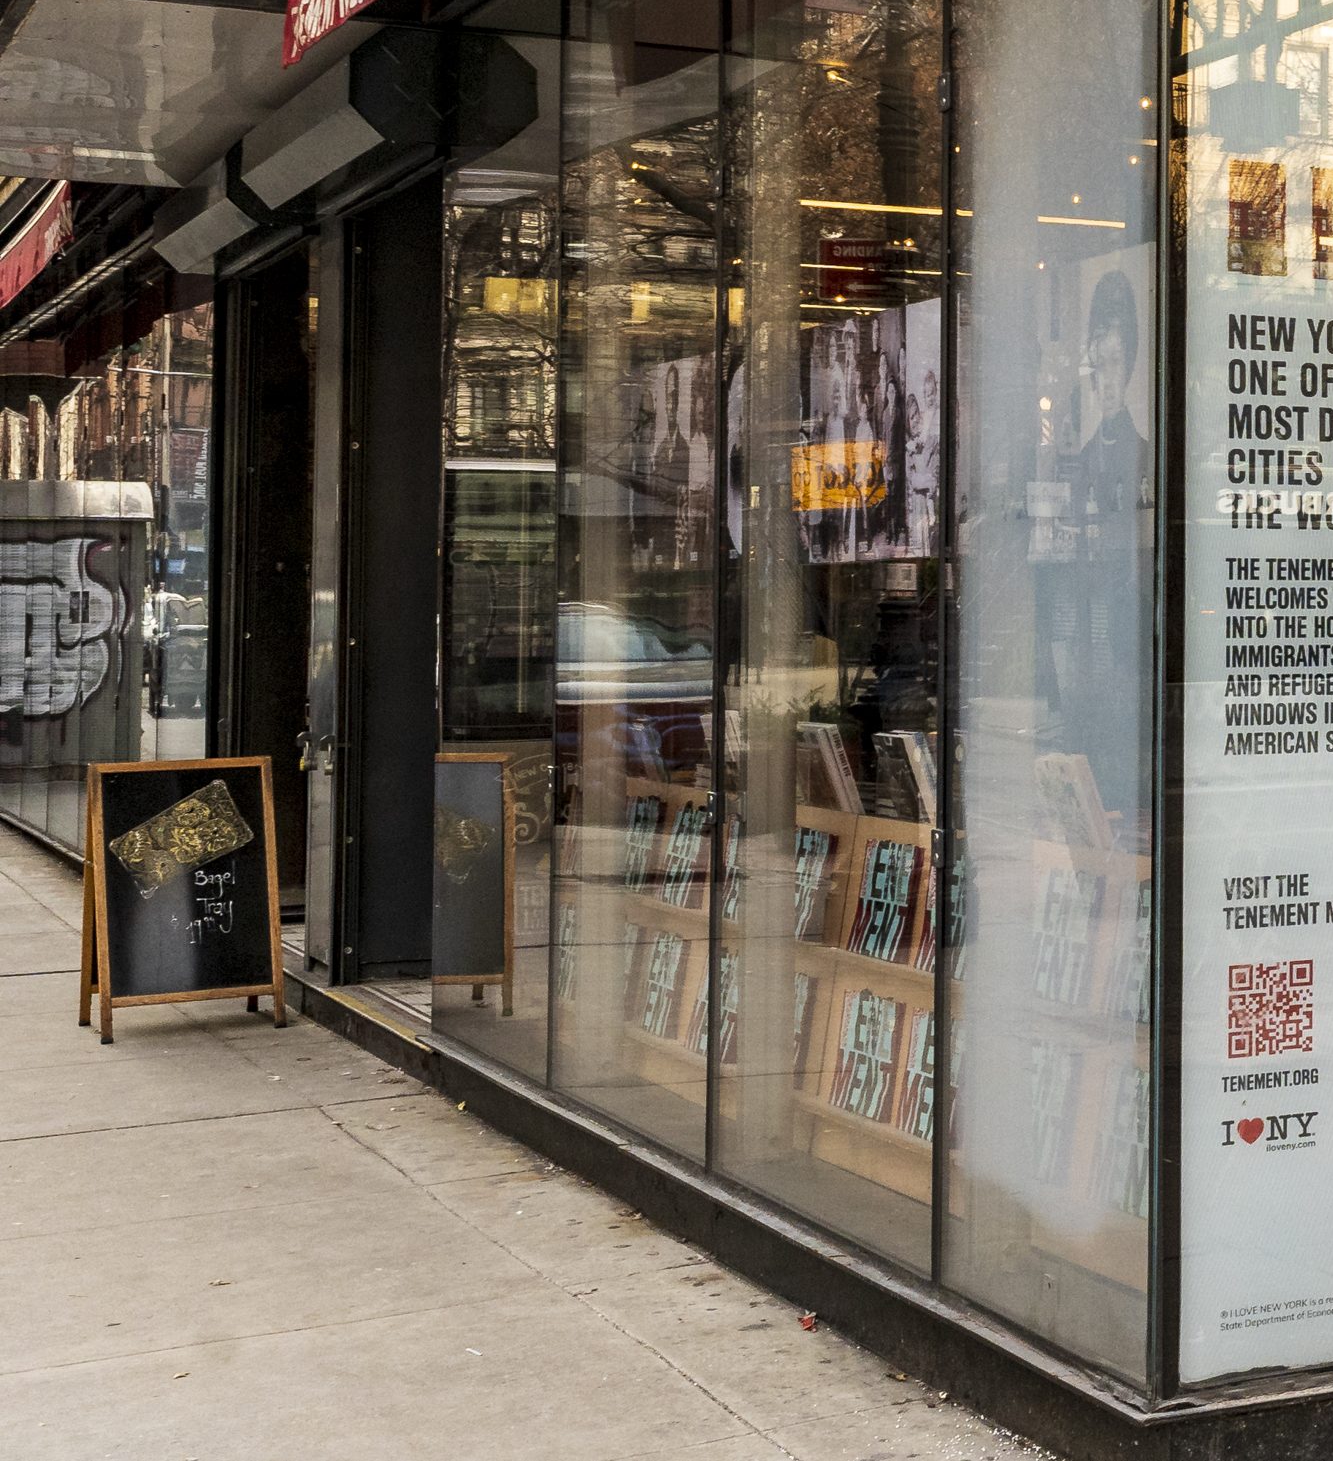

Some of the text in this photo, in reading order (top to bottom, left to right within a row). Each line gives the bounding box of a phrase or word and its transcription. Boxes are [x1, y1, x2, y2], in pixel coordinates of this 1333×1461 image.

[1227, 313, 1296, 352] NEW
[1228, 358, 1287, 396] ONE
[1228, 404, 1308, 442] MOST
[1228, 448, 1323, 487] CITIES
[1231, 493, 1282, 529] THE
[1226, 558, 1260, 580] THE
[1226, 587, 1328, 609] WELCOMES
[1226, 617, 1267, 638] INTO
[1273, 616, 1307, 638] THE
[1225, 674, 1262, 696] AND
[1225, 702, 1317, 726] WINDOWS
[1225, 731, 1319, 755] AMERICAN
[513, 765, 537, 781] NEW
[194, 859, 236, 899] Bagel
[1223, 873, 1309, 901] VISIT THE
[196, 897, 233, 933] Tray
[1223, 901, 1318, 930] TENEMENT
[1221, 1069, 1319, 1093] TENEMENT.ORG
[1221, 1120, 1235, 1146] I
[1266, 1139, 1316, 1153] iloveny.com
[1235, 1306, 1258, 1317] LOVE
[1260, 1302, 1282, 1314] NEW
[1284, 1298, 1308, 1311] YORK
[1309, 1298, 1316, 1307] is
[1220, 1320, 1243, 1331] State
[1245, 1313, 1295, 1330] Department
[1296, 1310, 1305, 1320] of
